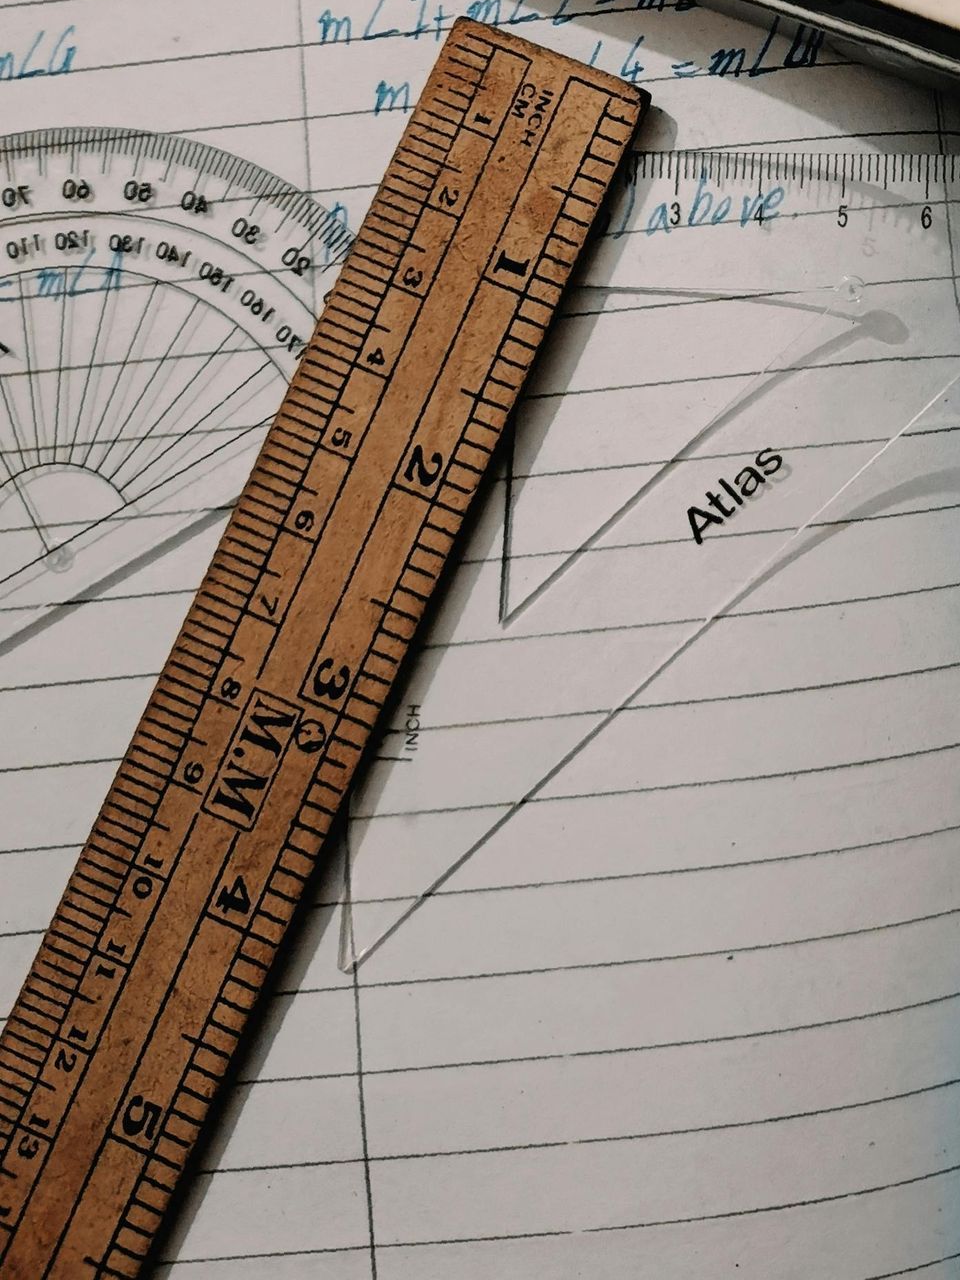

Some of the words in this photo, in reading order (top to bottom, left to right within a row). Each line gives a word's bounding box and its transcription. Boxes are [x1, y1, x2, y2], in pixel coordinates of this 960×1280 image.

[511, 81, 537, 120] CM
[519, 89, 555, 149] INCH
[437, 185, 460, 208] 2
[836, 206, 849, 230] 5
[921, 206, 933, 230] 6
[402, 264, 424, 289] 3
[494, 249, 531, 278] 1
[366, 346, 387, 368] 4
[330, 426, 354, 450] 5
[405, 444, 445, 488] 2
[680, 445, 784, 546] Atlas
[293, 509, 316, 534] 6
[259, 593, 281, 617] 7
[220, 676, 242, 701] 8
[312, 657, 351, 701] 3
[405, 702, 422, 753] INCH
[183, 761, 206, 785] 9
[214, 873, 254, 918] 4
[123, 1093, 164, 1139] 5
